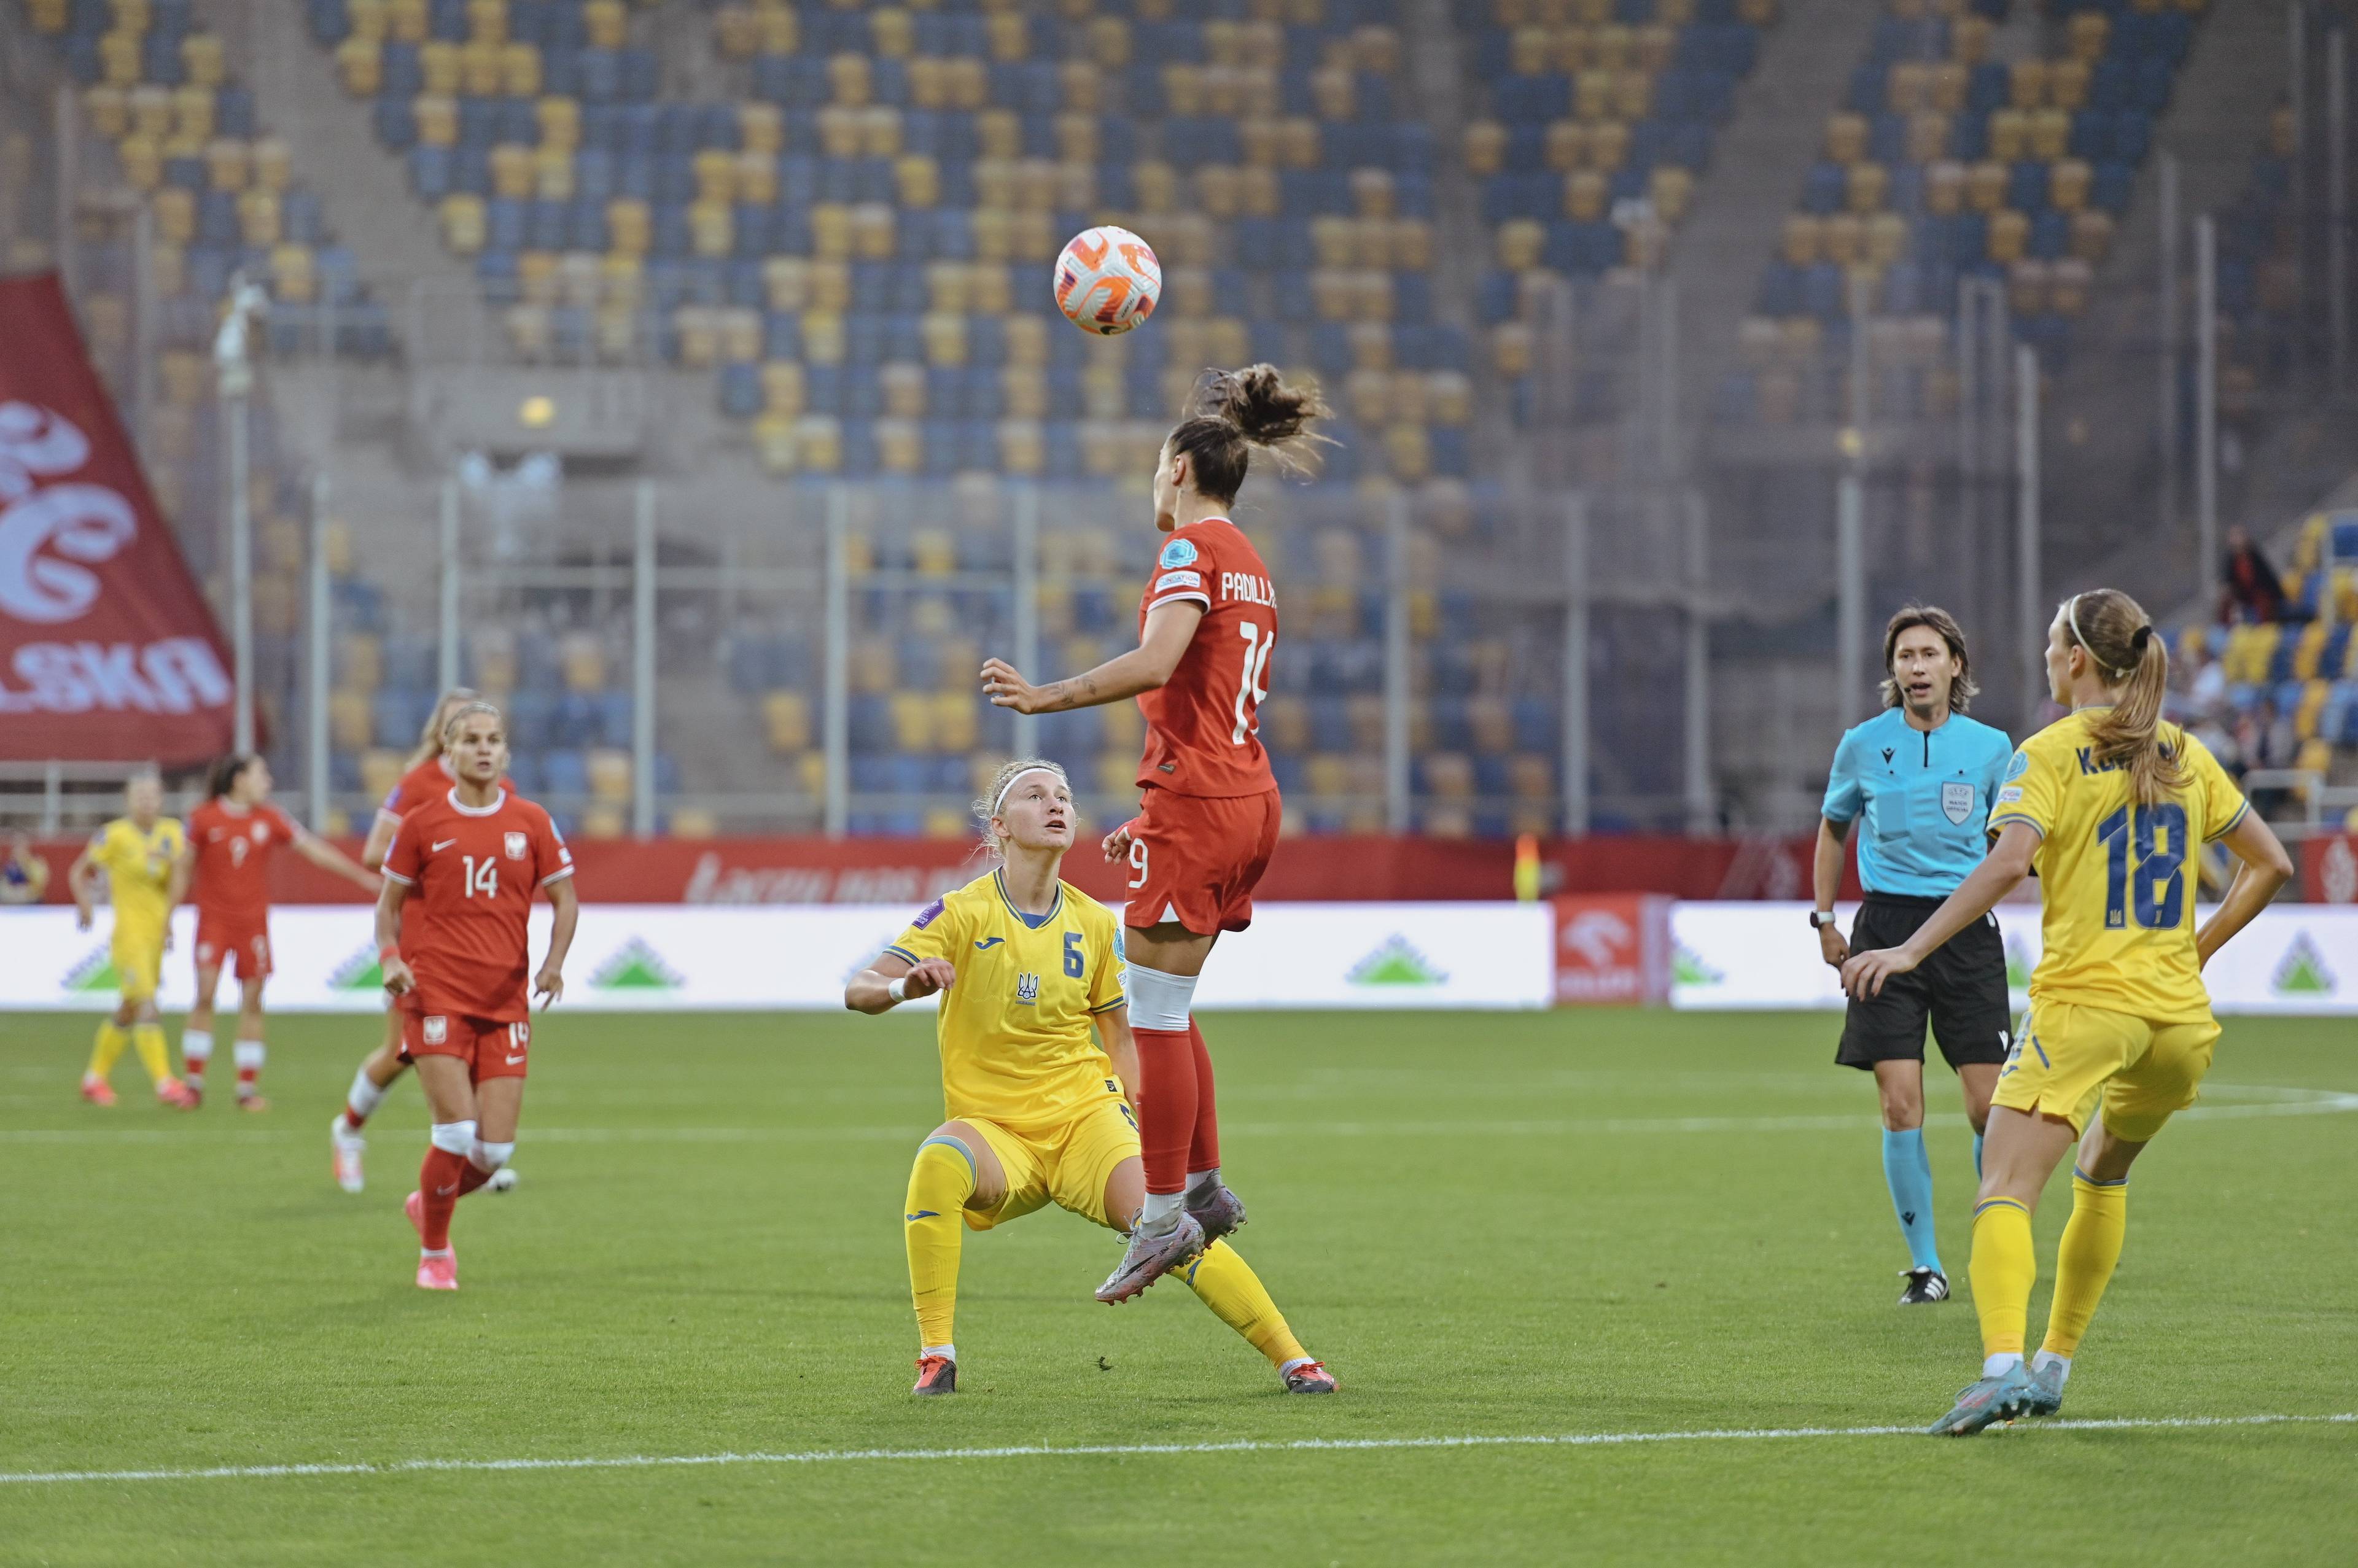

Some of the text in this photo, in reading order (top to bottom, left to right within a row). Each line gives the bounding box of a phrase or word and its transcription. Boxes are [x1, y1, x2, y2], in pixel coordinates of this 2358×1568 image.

[462, 855, 498, 899] 14
[1129, 837, 1149, 888] 9
[2096, 802, 2187, 930] 18
[1063, 931, 1084, 978] 6
[509, 1021, 529, 1051] 14
